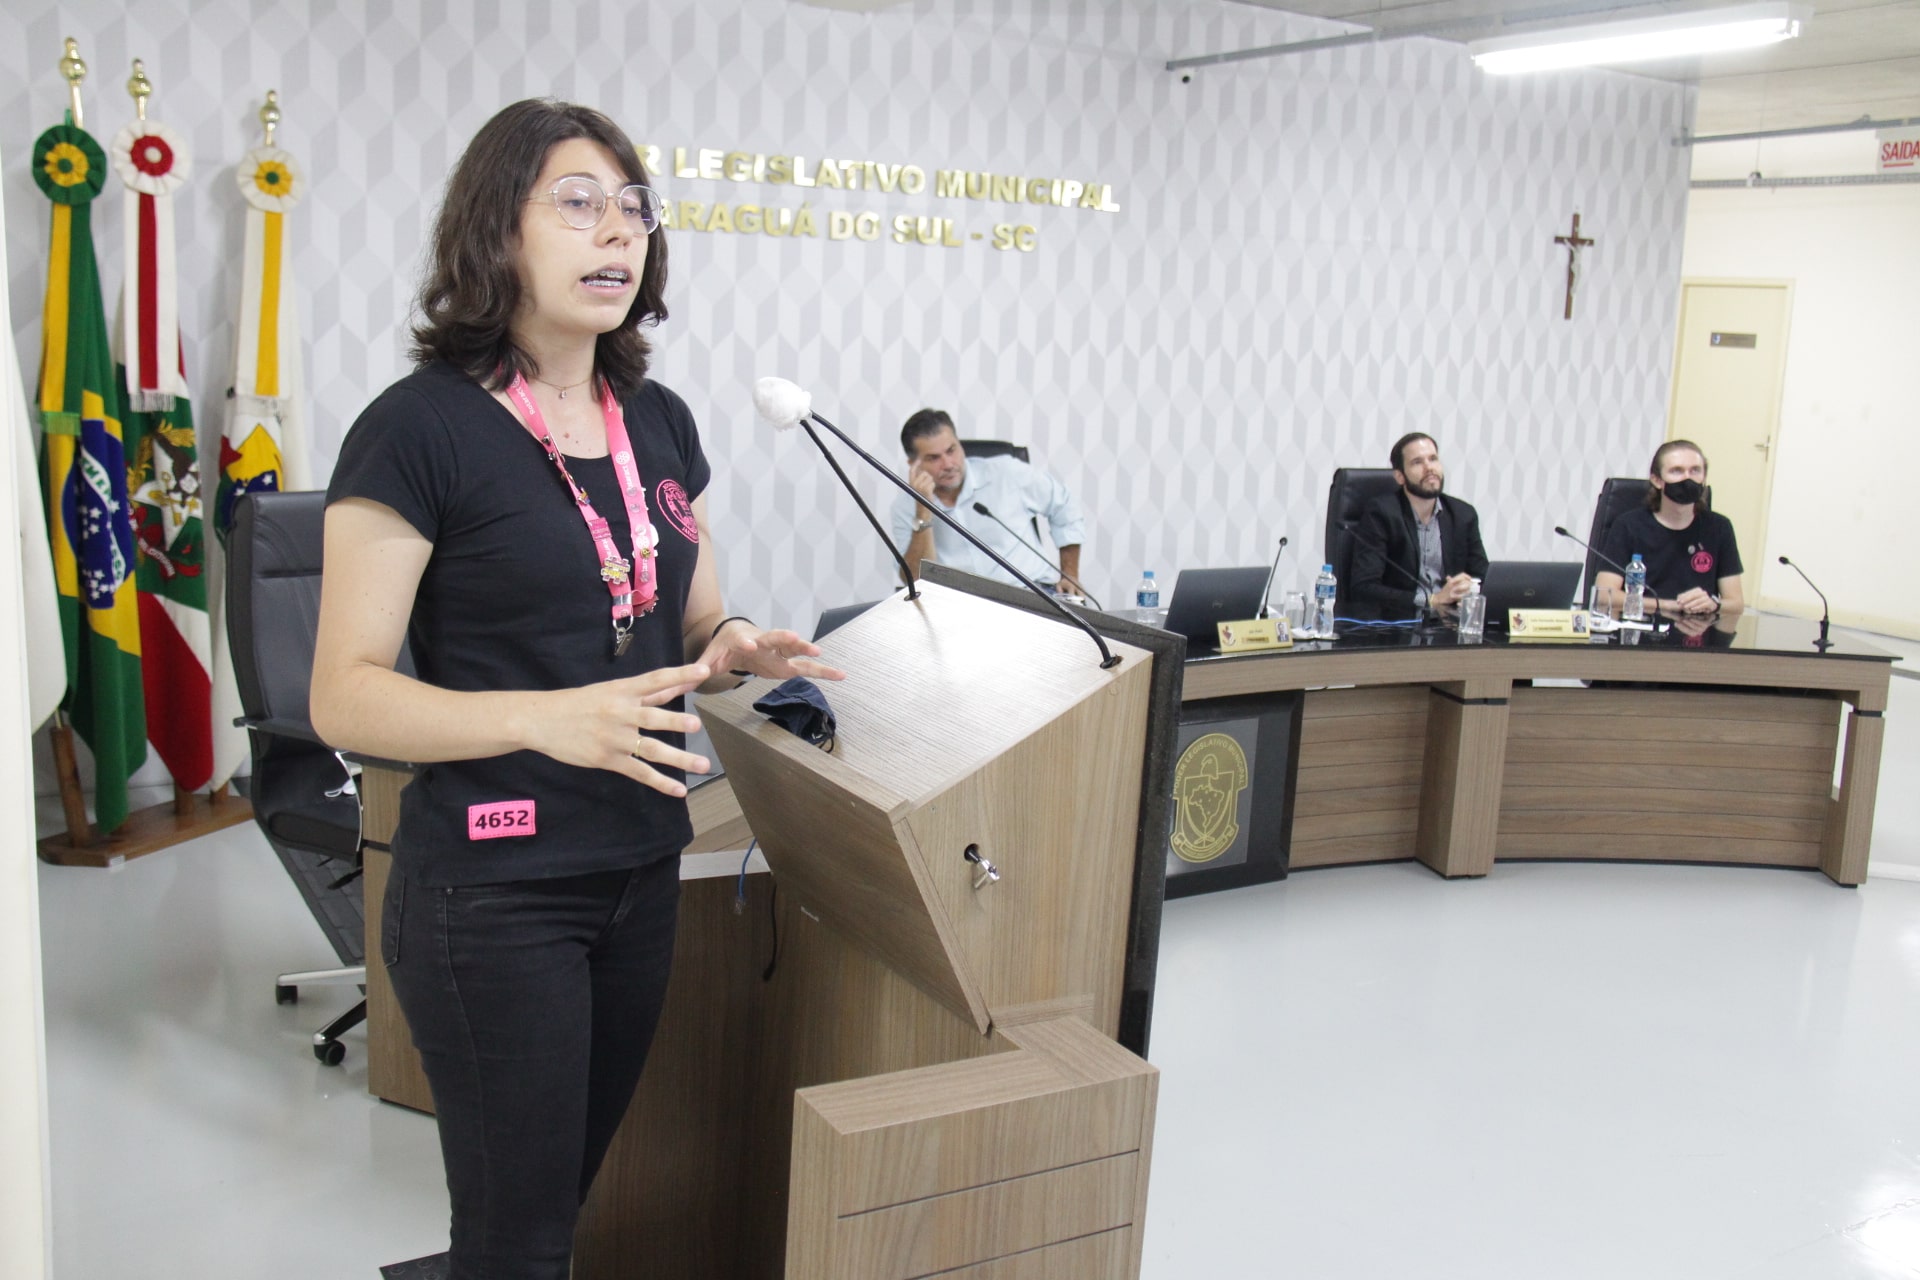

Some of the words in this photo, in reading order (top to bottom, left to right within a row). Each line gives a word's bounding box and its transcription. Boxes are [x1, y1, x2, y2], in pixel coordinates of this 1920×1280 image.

[674, 147, 926, 195] LEGISLATIVO
[935, 169, 1120, 213] MUNICIPAL
[829, 210, 880, 242] DO
[892, 214, 963, 248] SUL
[992, 223, 1037, 252] SC
[475, 810, 529, 830] 4652
